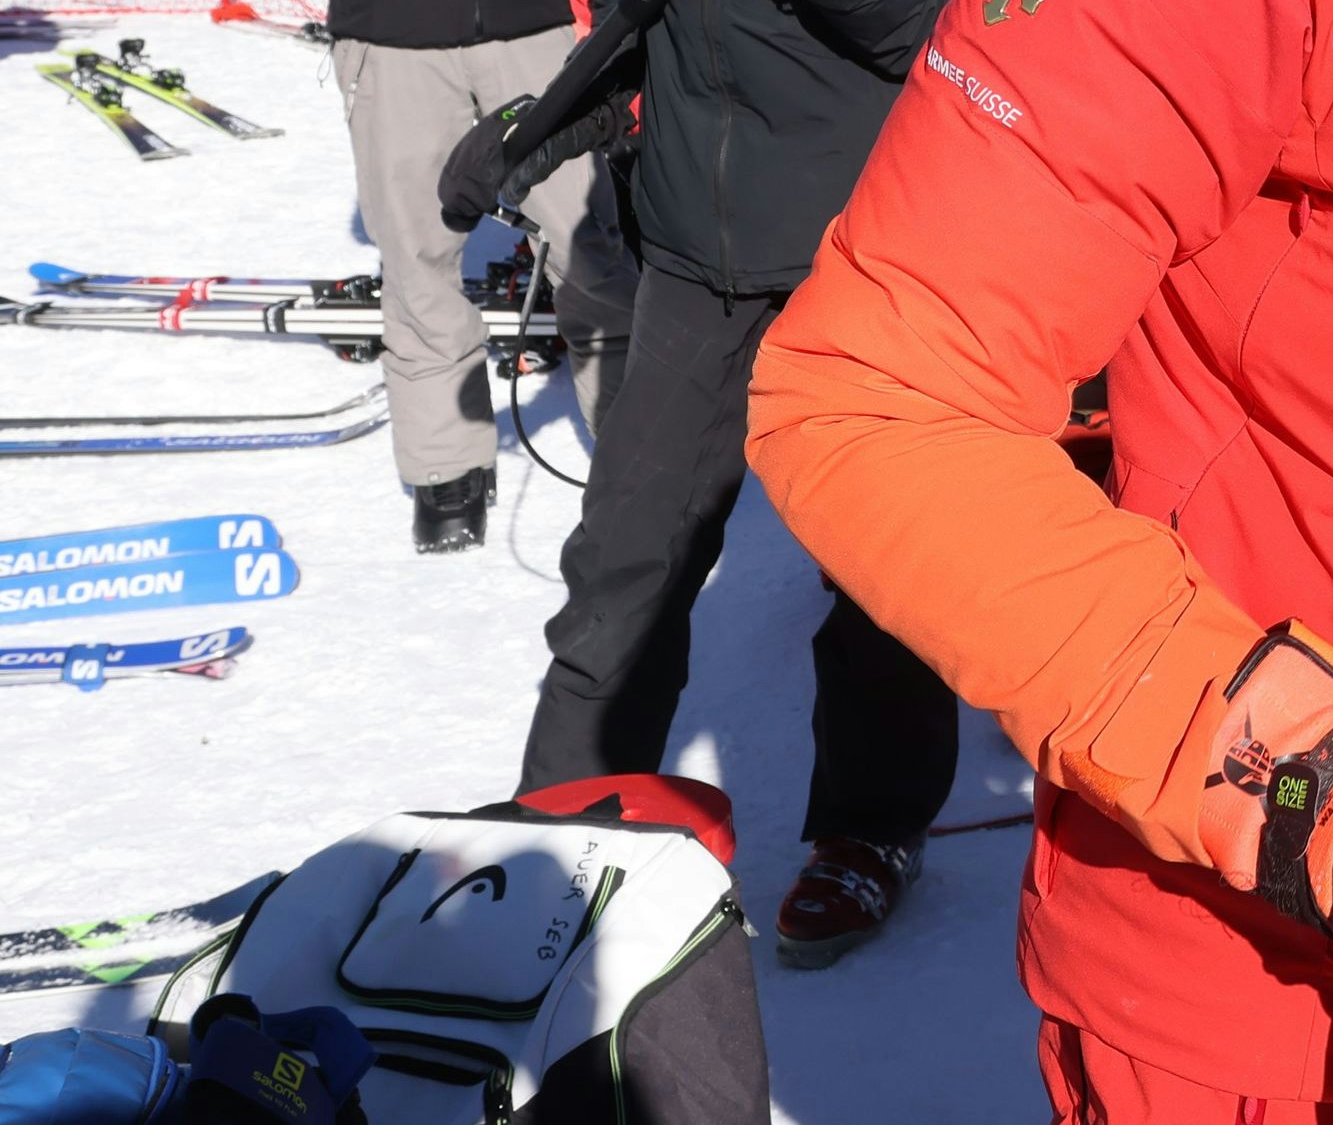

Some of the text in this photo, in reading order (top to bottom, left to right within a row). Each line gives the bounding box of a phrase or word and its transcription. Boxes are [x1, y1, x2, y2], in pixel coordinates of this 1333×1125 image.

[965, 76, 1023, 128] SUISSE
[0, 570, 184, 612] SALOMON
[1276, 789, 1306, 810] SIZE
[1279, 775, 1309, 793] ONE
[537, 841, 599, 960] AUER SEB
